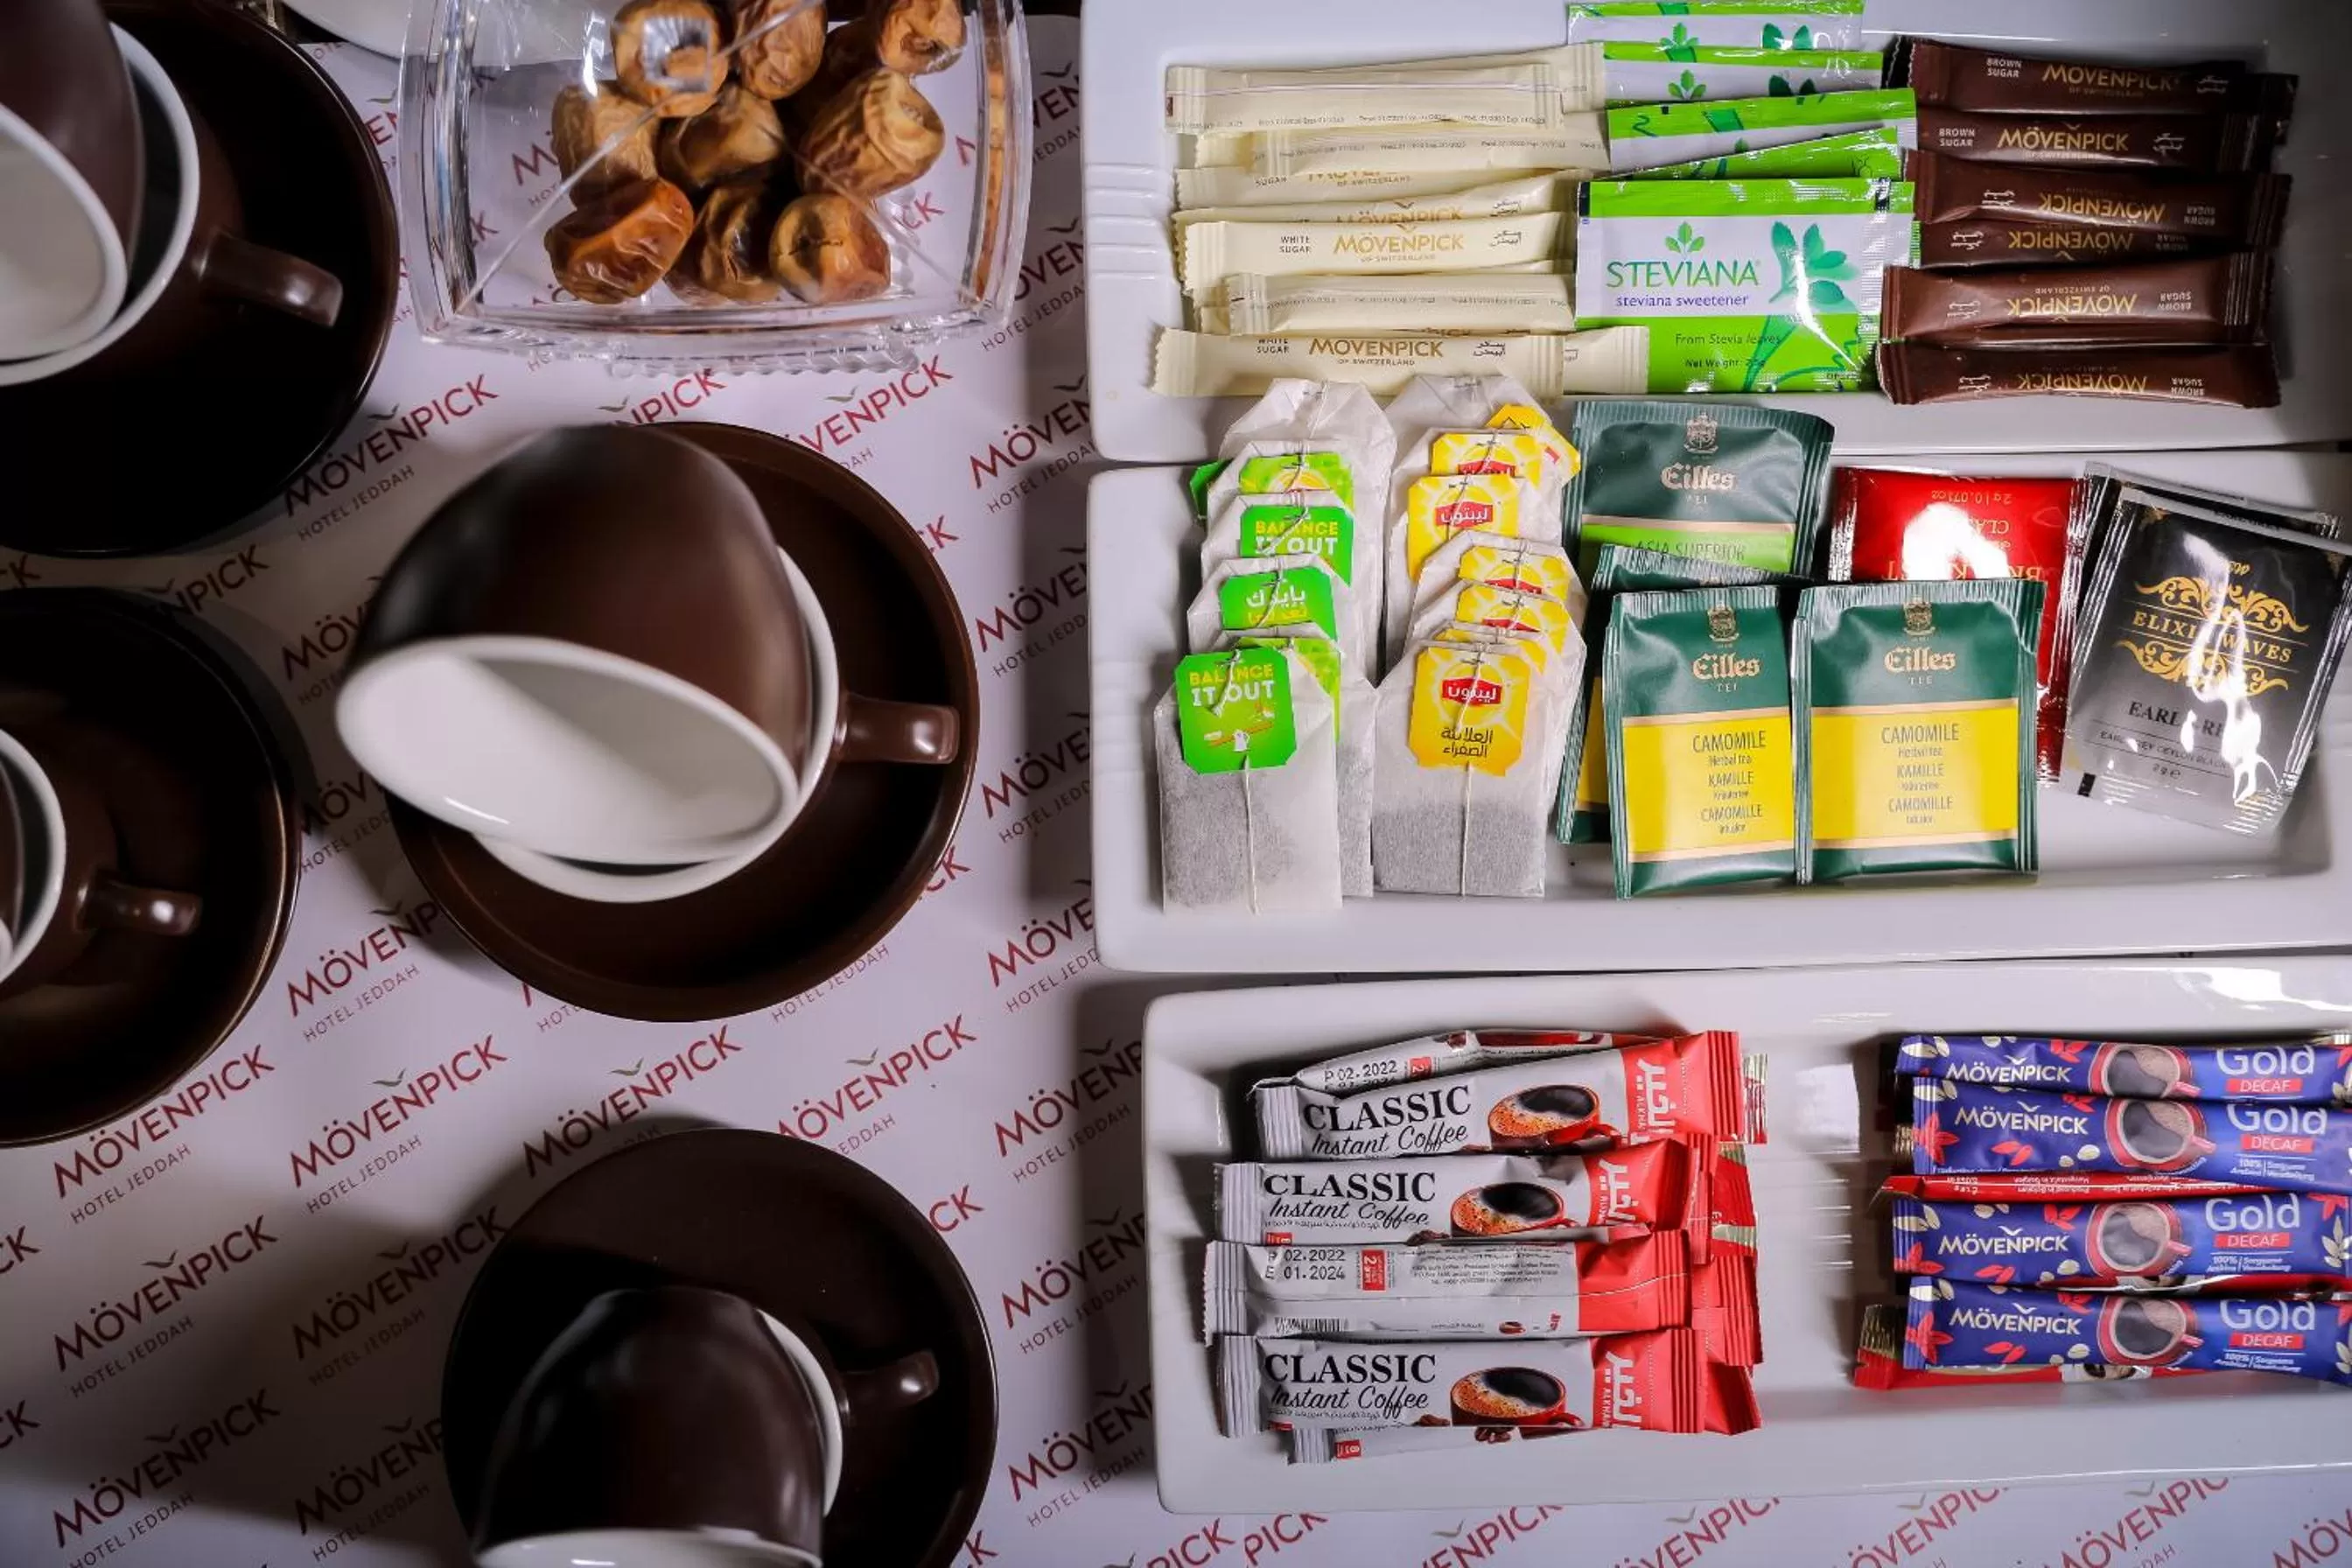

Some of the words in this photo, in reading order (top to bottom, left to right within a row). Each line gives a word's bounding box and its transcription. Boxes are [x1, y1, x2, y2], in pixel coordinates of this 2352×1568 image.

[1986, 58, 2022, 69] BROWN
[1987, 67, 2020, 79] SUGAR
[1938, 128, 1975, 138] BROWN
[1939, 137, 1974, 147] SUGAR
[1997, 126, 2129, 151] MÖVENPICK
[2038, 192, 2166, 223] MÖVENPICK
[1279, 245, 1311, 254] SUGAR
[1280, 235, 1311, 244] WHITE
[1334, 233, 1464, 254] MÖVENPICK
[2008, 230, 2133, 254] MÖVENPICK
[1606, 261, 1760, 287] STEVIANA
[1033, 282, 1085, 323] JEDDA
[1615, 295, 1672, 308] steviana
[1675, 295, 1749, 307] sweetener
[2157, 301, 2192, 312] BROWN
[2159, 290, 2192, 302] SUGAR
[1256, 345, 1291, 354] SUGAR
[1675, 333, 1705, 345] From
[1709, 333, 1742, 345] Stevia
[1746, 334, 1781, 345] leaves
[1685, 359, 1703, 368] Net
[2170, 376, 2203, 387] SUGAR
[799, 354, 954, 455] VENPICK
[286, 374, 500, 517] MÖVENPICK
[970, 398, 1091, 490] MÖVEN
[1661, 462, 1737, 490] Eilles
[298, 504, 350, 542] HOTEL
[352, 465, 416, 511] JEDDAH
[987, 480, 1039, 514] HOTEL
[1256, 521, 1339, 536] BALNCE
[1287, 536, 1339, 556] OUT
[1637, 540, 1670, 553] ASIA
[1676, 542, 1746, 561] SUPERIOR
[2132, 610, 2198, 640] ELIXI
[993, 644, 1047, 678] HOTEL
[1047, 612, 1088, 647] JEDD
[1189, 664, 1274, 686] BALNCE
[1691, 650, 1761, 680] Eilles
[1884, 646, 1957, 676] Eilles
[1191, 686, 1216, 707] IT
[1225, 680, 1275, 703] OUT
[1447, 685, 1497, 704] ليبون
[2128, 701, 2181, 727] EARL
[1692, 731, 1767, 753] CAMOMILE
[1881, 723, 1960, 744] CAMOMILE
[1708, 771, 1754, 788] KAMILLE
[1896, 763, 1945, 779] KAMILLE
[1700, 804, 1763, 822] CAMOMILLE
[1887, 795, 1954, 813] CAMOMILLE
[998, 810, 1050, 845] HOTEL
[300, 838, 351, 875] HOTEL
[286, 899, 439, 1018] MÖVENP
[1005, 972, 1060, 1014] HOTEL
[1059, 947, 1099, 986] JEDD
[303, 1006, 354, 1043] HOTEL
[351, 964, 421, 1009] JEDDAH
[1337, 1059, 1398, 1081] 02.2022
[1945, 1060, 2072, 1083] MÖVENPICK
[2216, 1045, 2315, 1076] Gold
[2239, 1079, 2292, 1093] DECAF
[290, 1034, 509, 1188] MÖVENPICK
[522, 1025, 745, 1180] MÖVENPICK
[1304, 1085, 1472, 1132] CLASSIC
[53, 1043, 276, 1200] MÖVENPICK
[837, 1112, 898, 1156] EDDAH
[1955, 1104, 2089, 1136] MÖVENPICK
[2226, 1104, 2328, 1135] Gold
[1012, 1144, 1067, 1185] HOTEL
[1066, 1102, 1131, 1151] JEDDAH
[1312, 1132, 1390, 1155] Instant
[1399, 1121, 1468, 1154] Coffee
[2250, 1137, 2302, 1152] DECAF
[70, 1184, 124, 1226] HOTEL
[125, 1143, 192, 1190] JEDDAH
[305, 1175, 359, 1215] HOTEL
[358, 1135, 424, 1181] JEDDAH
[1263, 1172, 1437, 1202] CLASSIC
[1269, 1197, 1349, 1220] Instant
[1359, 1202, 1430, 1229] Coffee
[2205, 1193, 2300, 1232] Gold
[1284, 1249, 1347, 1263] 02.2022
[1937, 1234, 2070, 1256] MÖVENPICK
[2227, 1235, 2280, 1249] DECAF
[290, 1205, 511, 1362] MÖVENPICK
[999, 1212, 1146, 1331] MÖVEN
[1283, 1265, 1346, 1281] 01.2024
[53, 1214, 277, 1372] MÖVENPICK
[1949, 1306, 2082, 1336] MÖVENPICK
[2220, 1299, 2316, 1331] Gold
[308, 1348, 362, 1388] HOTEL
[362, 1308, 427, 1354] JEDDAH
[1018, 1312, 1076, 1355] HOTEL
[2242, 1334, 2293, 1348] DECAF
[70, 1359, 125, 1400] HOTEL
[126, 1315, 195, 1362] JEDDAH
[1264, 1353, 1437, 1384] CLASSIC
[1270, 1385, 1350, 1410] Instant
[1359, 1383, 1430, 1419] Coffee
[1005, 1382, 1152, 1502] MÖVEN
[52, 1388, 281, 1549] MÖVENPICK
[294, 1416, 444, 1536] MÖVENP
[1026, 1482, 1082, 1530] HOTEL
[69, 1533, 125, 1568] HOTEL
[126, 1490, 196, 1538] JEDDAH
[312, 1522, 364, 1564] HOTEL
[364, 1481, 431, 1530] JEDDAH
